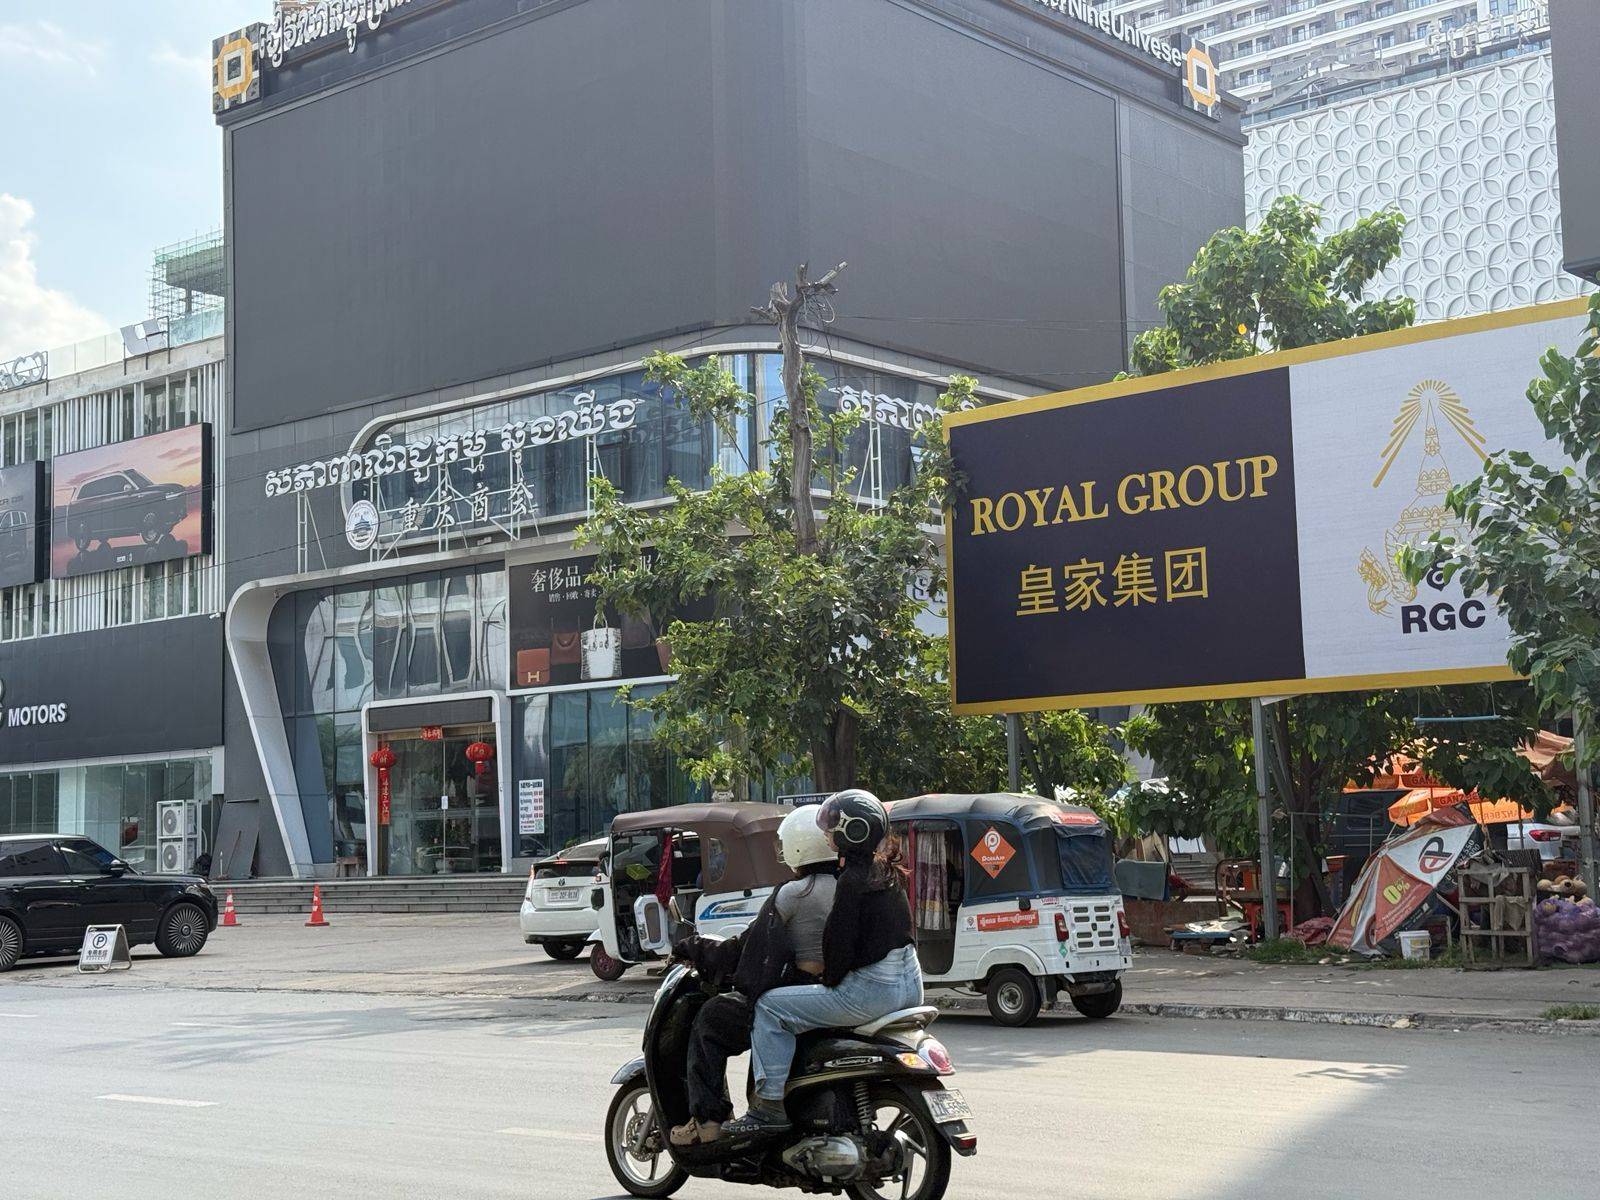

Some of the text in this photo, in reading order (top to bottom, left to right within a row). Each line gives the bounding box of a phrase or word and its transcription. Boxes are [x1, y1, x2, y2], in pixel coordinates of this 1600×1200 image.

[399, 479, 535, 532] 重庆商会
[970, 454, 1279, 536] ROYAL GROUP
[1016, 546, 1209, 617] 皇家集团
[1401, 600, 1486, 634] RGC
[527, 670, 540, 683] H
[8, 702, 67, 727] MOTORS
[1382, 879, 1411, 905] 0%
[729, 1124, 760, 1133] crocs
